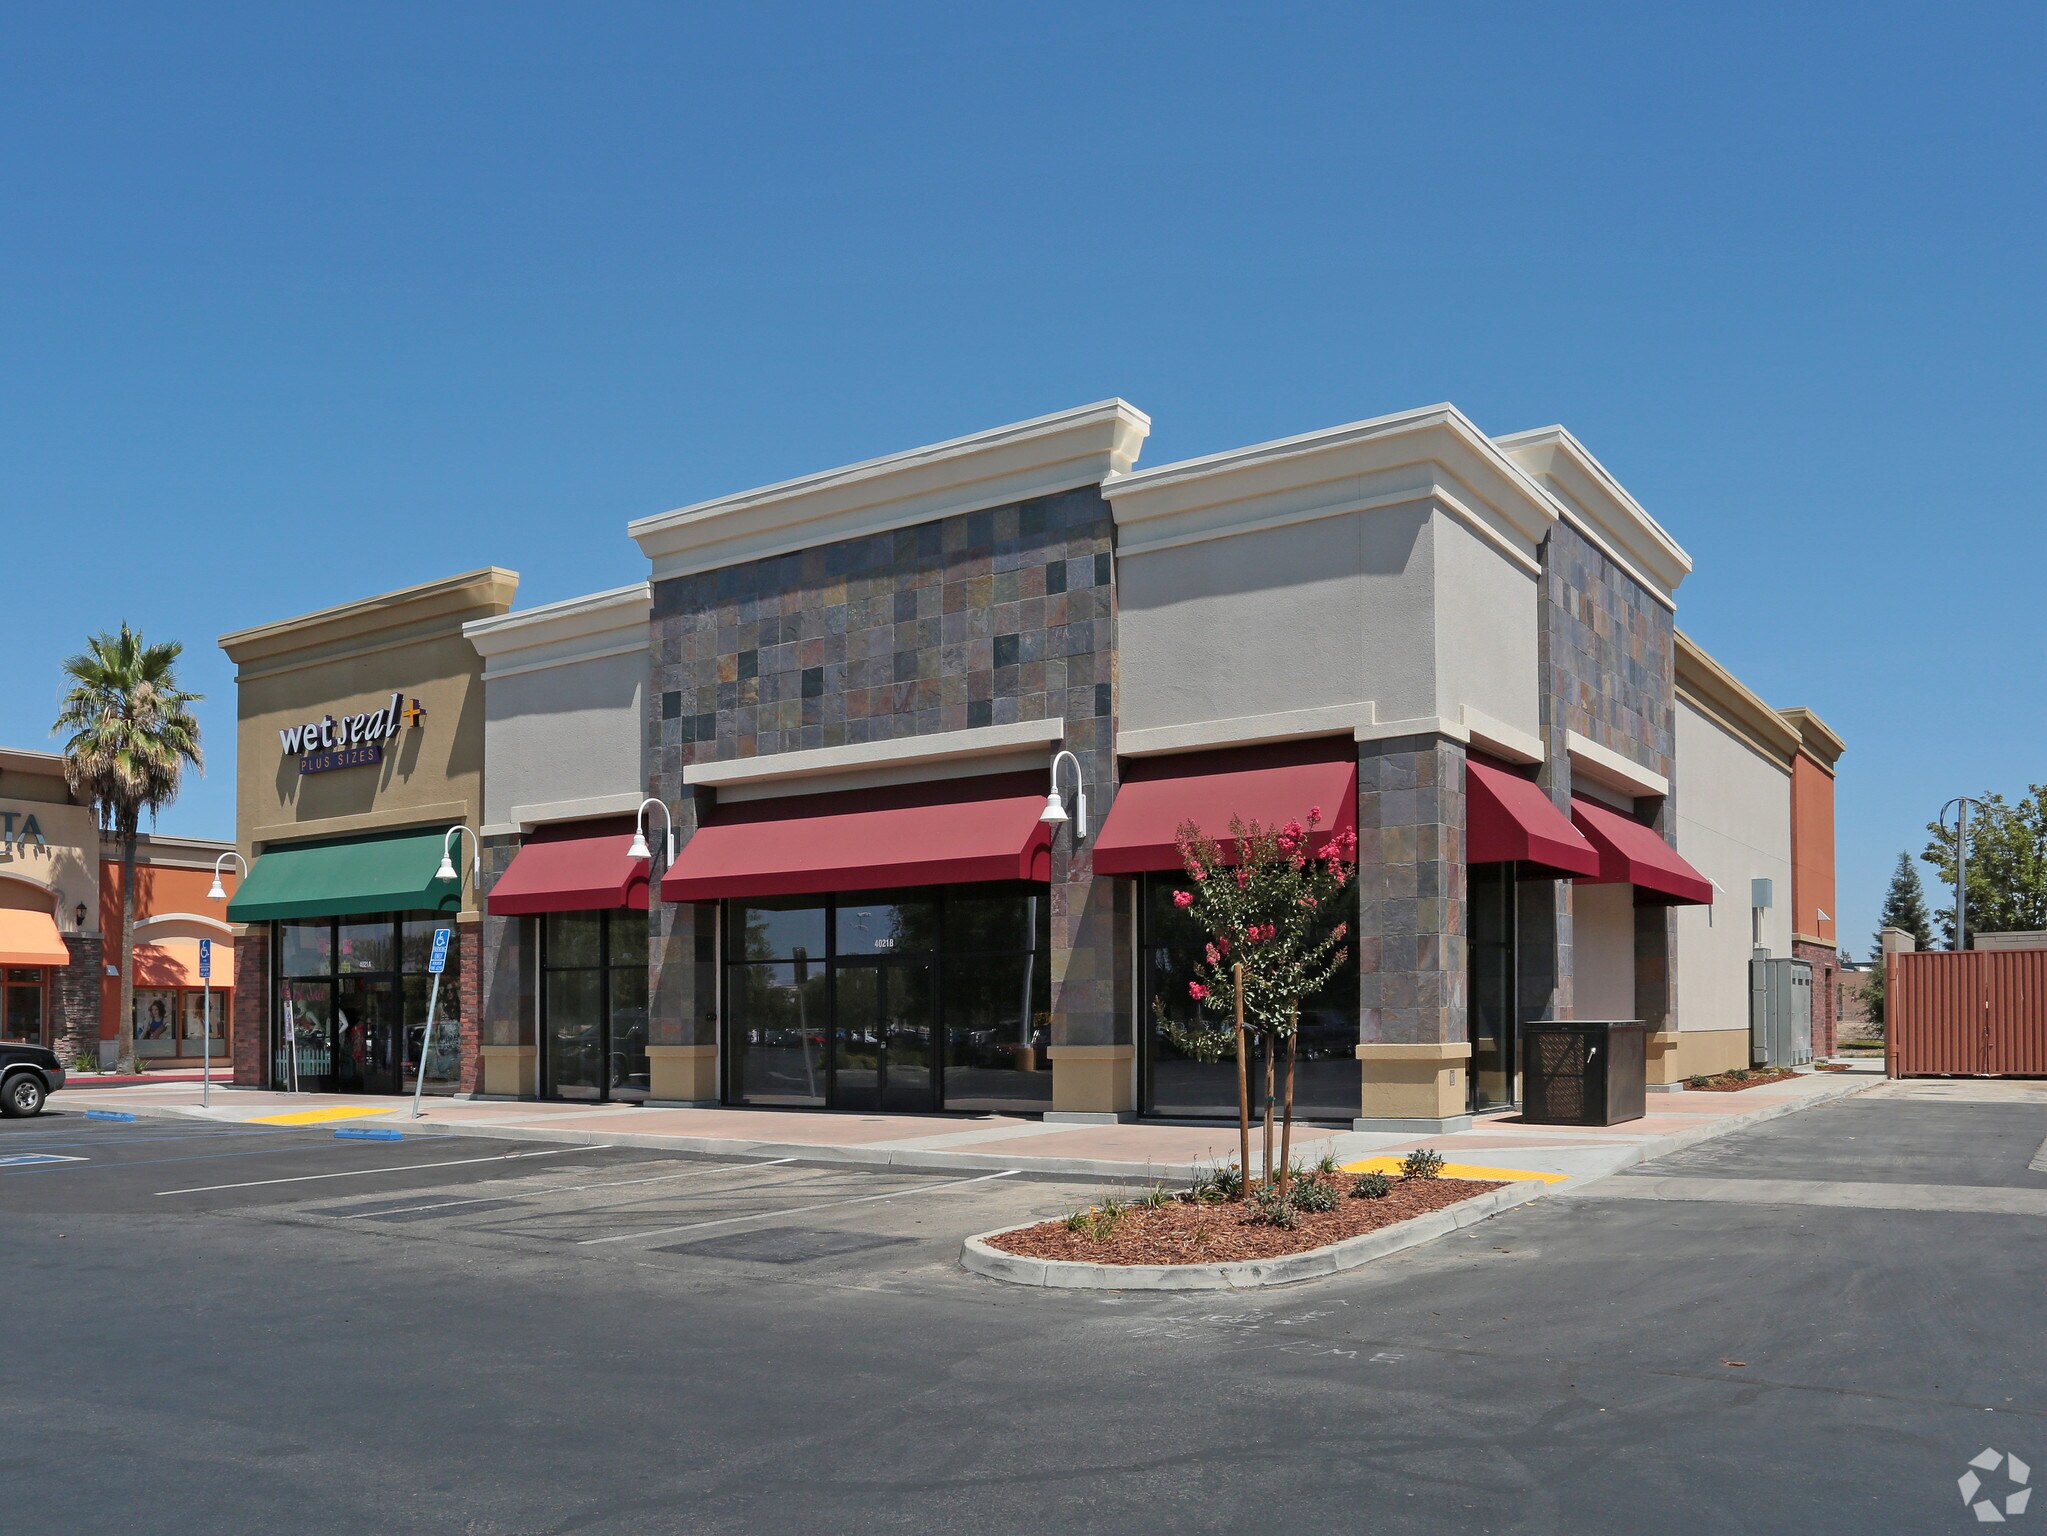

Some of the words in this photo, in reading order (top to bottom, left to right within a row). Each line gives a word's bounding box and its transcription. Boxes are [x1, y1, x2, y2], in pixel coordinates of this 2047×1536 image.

[279, 715, 335, 756] wet
[337, 691, 403, 745] seal
[301, 755, 330, 772] PLUS
[337, 748, 375, 765] SIZES
